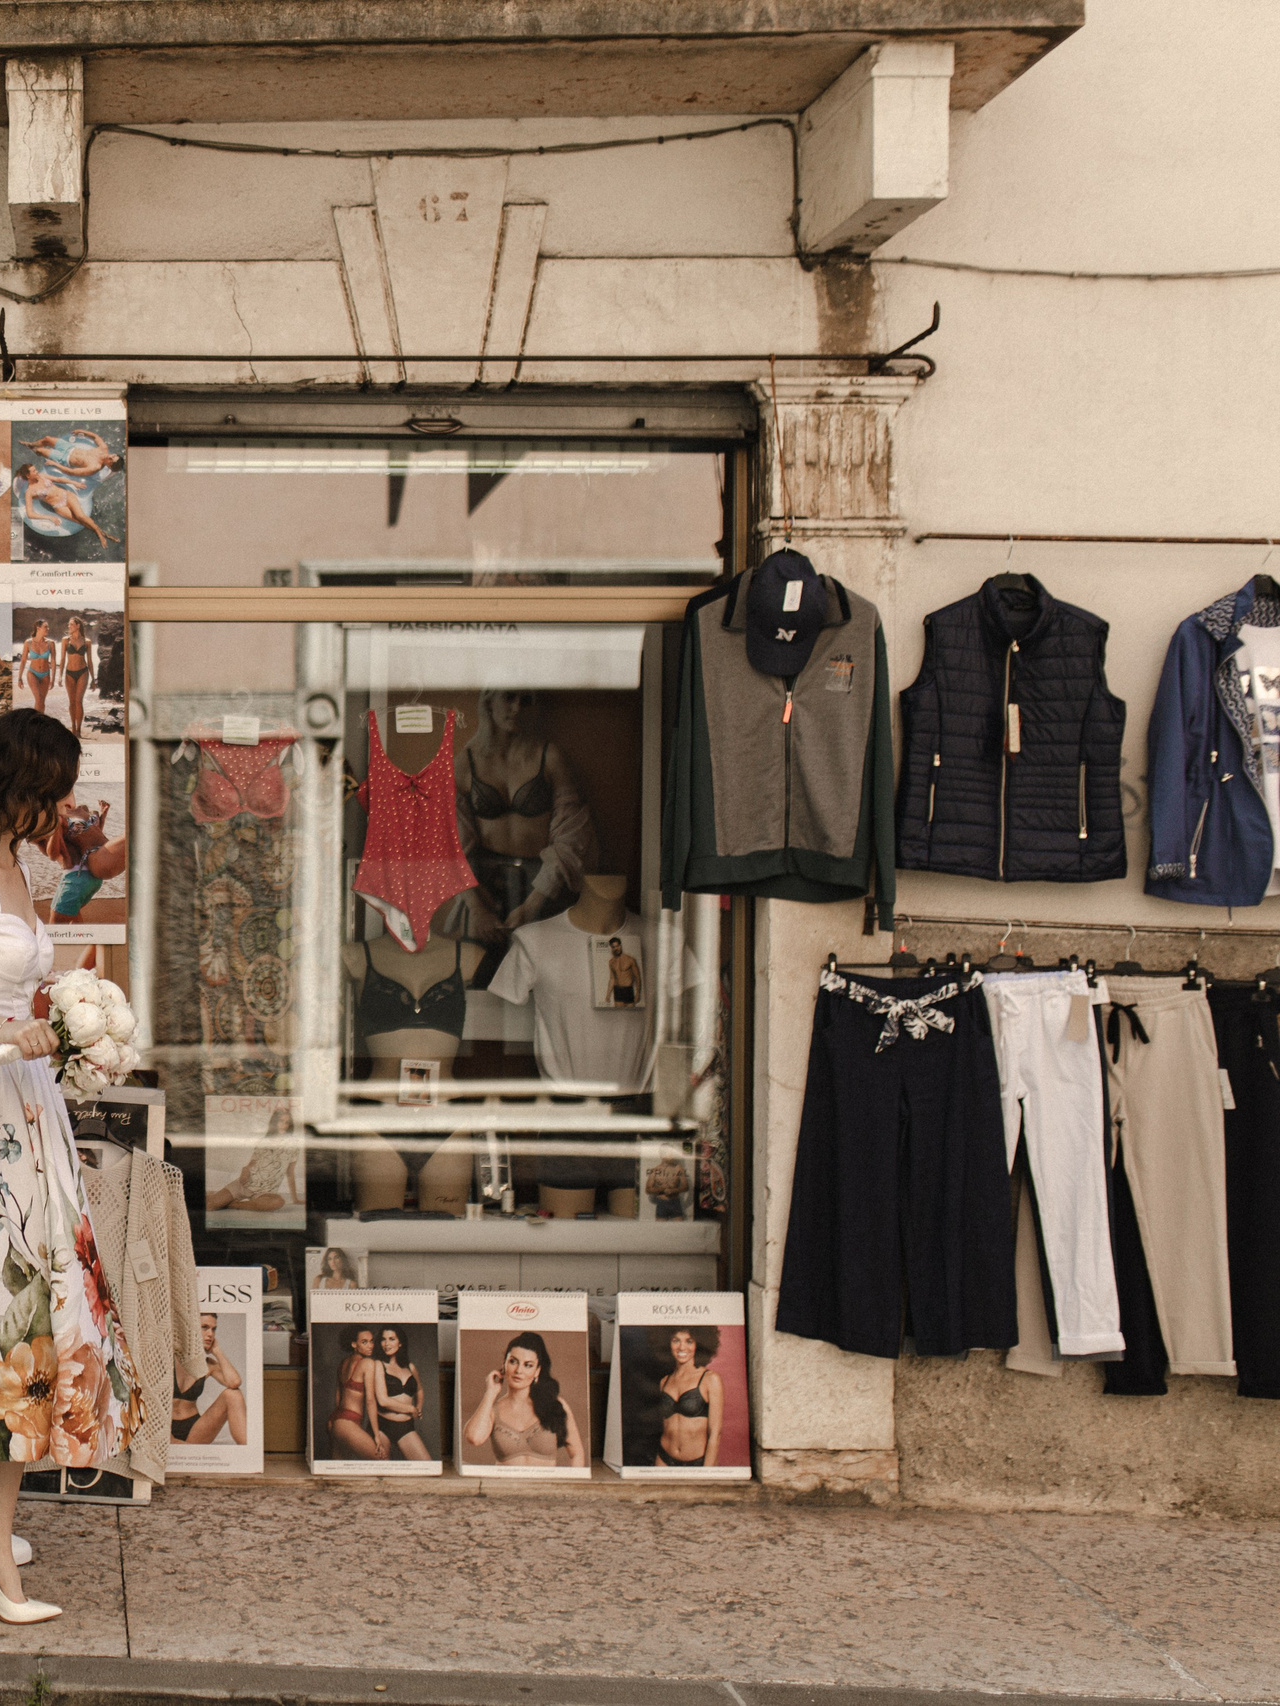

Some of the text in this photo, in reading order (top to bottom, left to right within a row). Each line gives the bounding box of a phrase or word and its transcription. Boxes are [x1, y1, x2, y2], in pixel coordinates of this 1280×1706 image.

[388, 622, 520, 634] PASSIONATA
[344, 1302, 404, 1312] ROSA FAIA
[651, 1304, 711, 1315] ROSA FAIA
